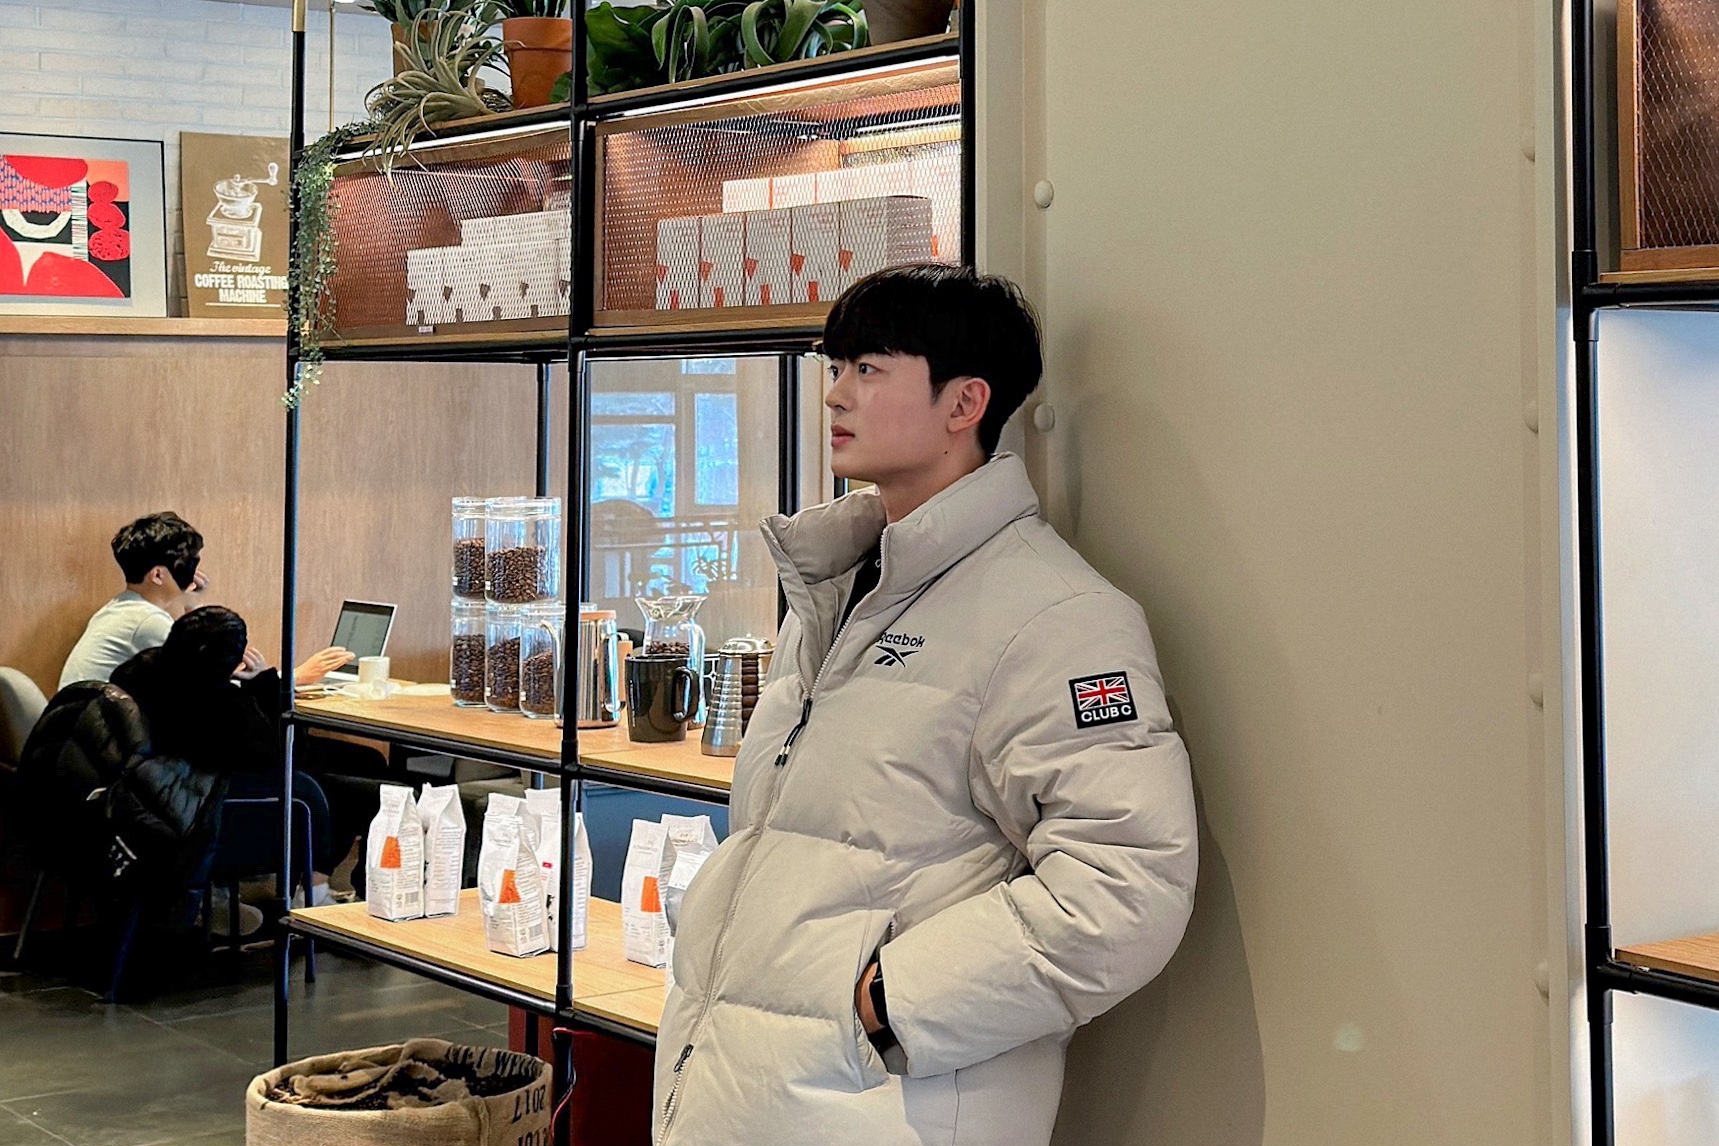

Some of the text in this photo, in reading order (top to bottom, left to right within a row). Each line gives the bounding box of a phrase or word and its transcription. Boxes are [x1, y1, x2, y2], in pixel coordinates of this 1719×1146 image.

[209, 261, 272, 275] The vintage
[194, 273, 289, 289] COFFEE ROASTING
[218, 288, 267, 303] MACHINE
[1081, 704, 1132, 722] CLUB C
[512, 1085, 546, 1123] 2017
